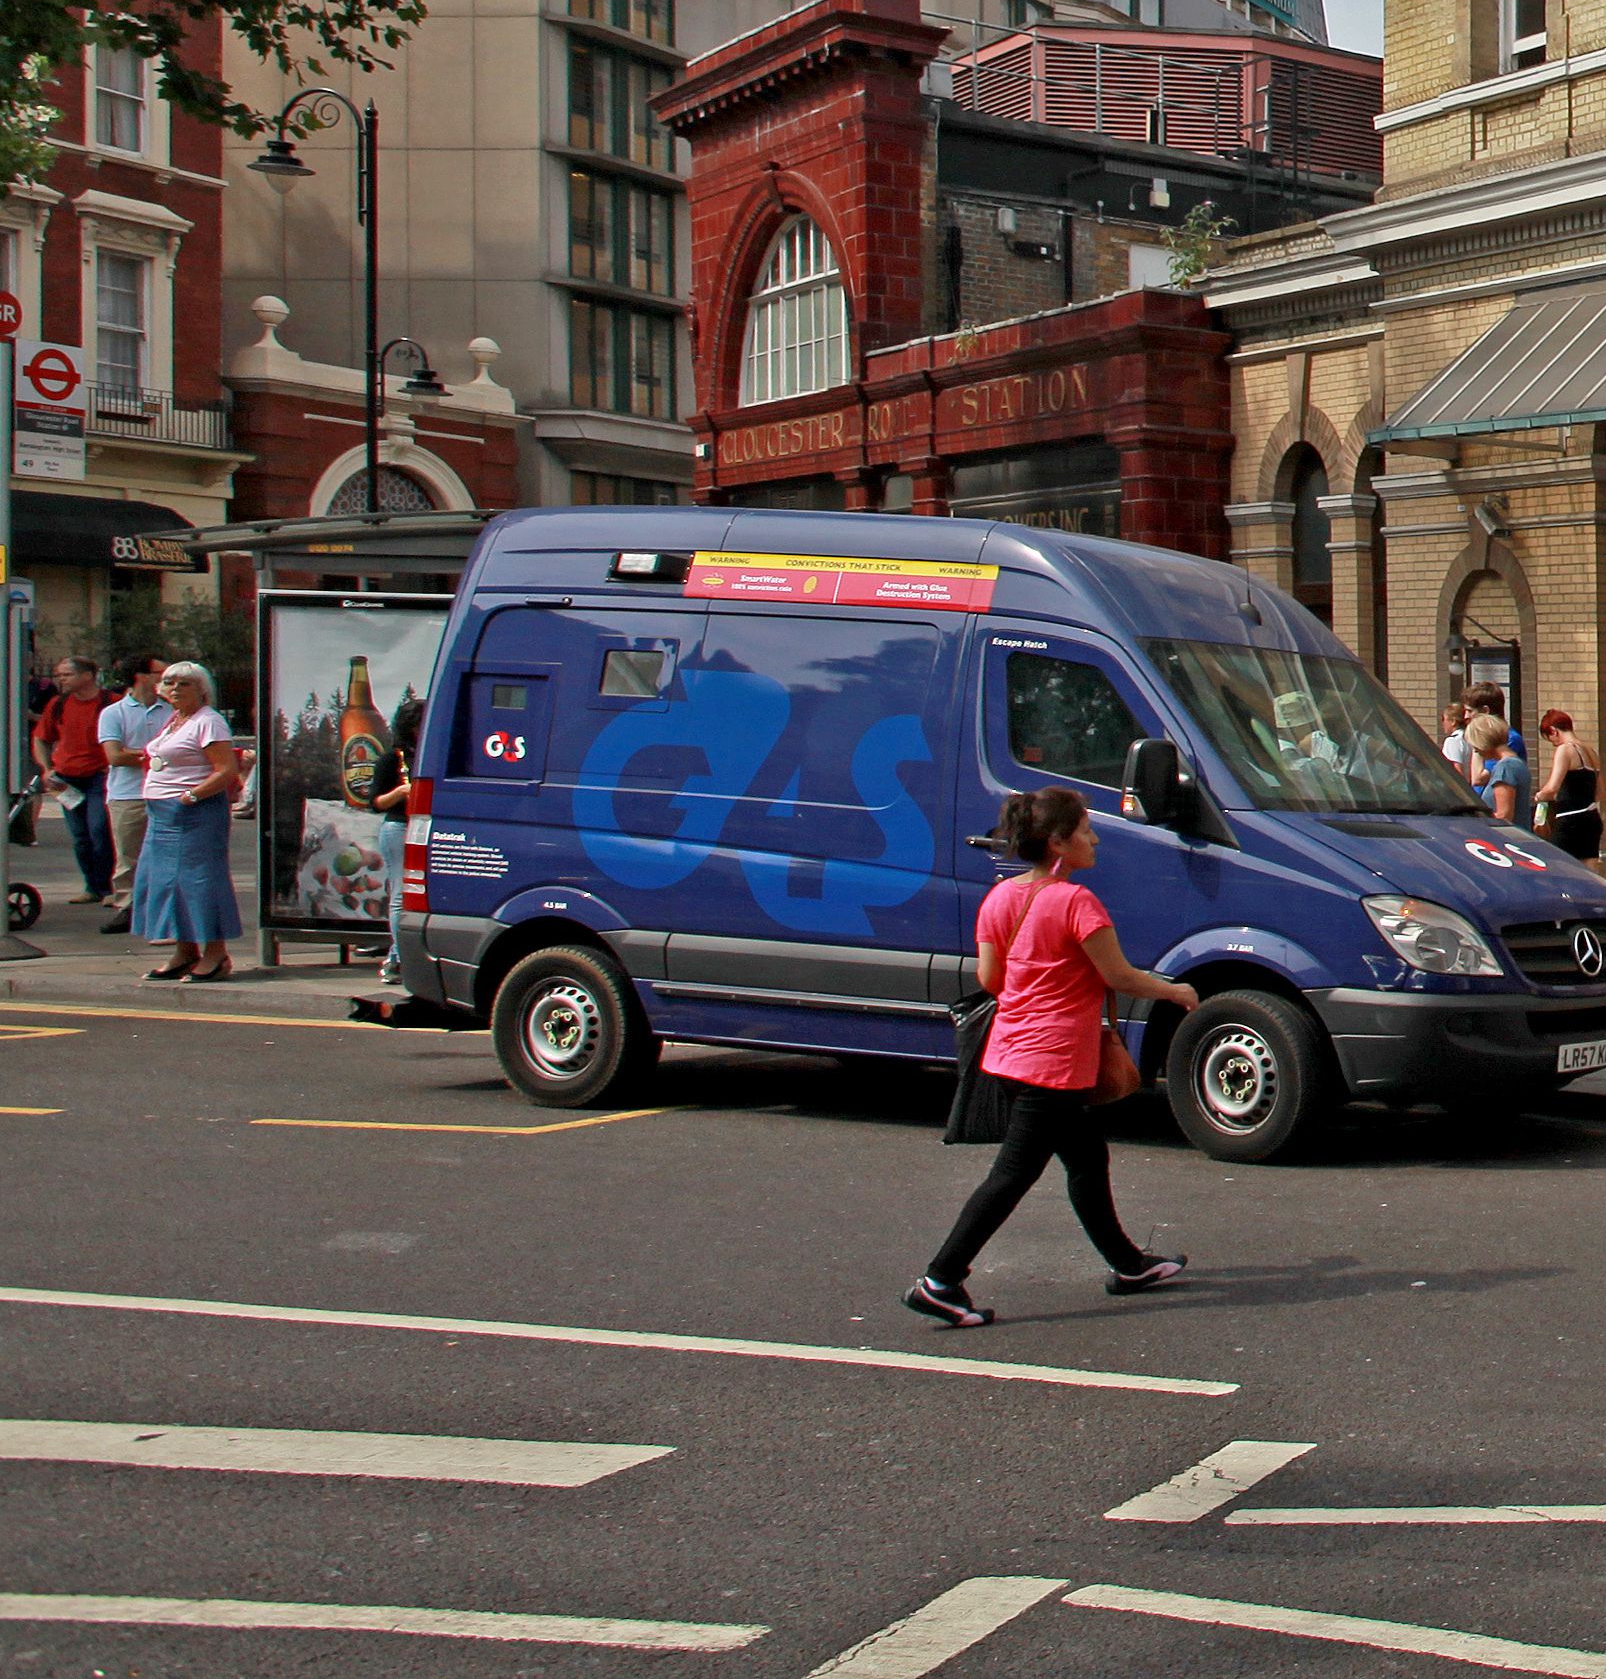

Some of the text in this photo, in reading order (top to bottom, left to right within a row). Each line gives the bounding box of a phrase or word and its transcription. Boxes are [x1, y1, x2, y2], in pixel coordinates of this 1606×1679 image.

[721, 413, 845, 465] GLOUCESTER
[962, 364, 1090, 426] STATION
[709, 555, 751, 566] WARNING
[785, 558, 902, 572] CONVICTIONS THAT STICK
[938, 566, 983, 577] WARNING
[740, 574, 787, 585] SmartWater
[882, 581, 909, 591] Armed
[910, 582, 928, 592] with
[875, 588, 952, 601] Destruction System
[991, 637, 1048, 650] Escape Hatch
[572, 670, 935, 937] G4S
[1562, 1045, 1597, 1070] LR57
